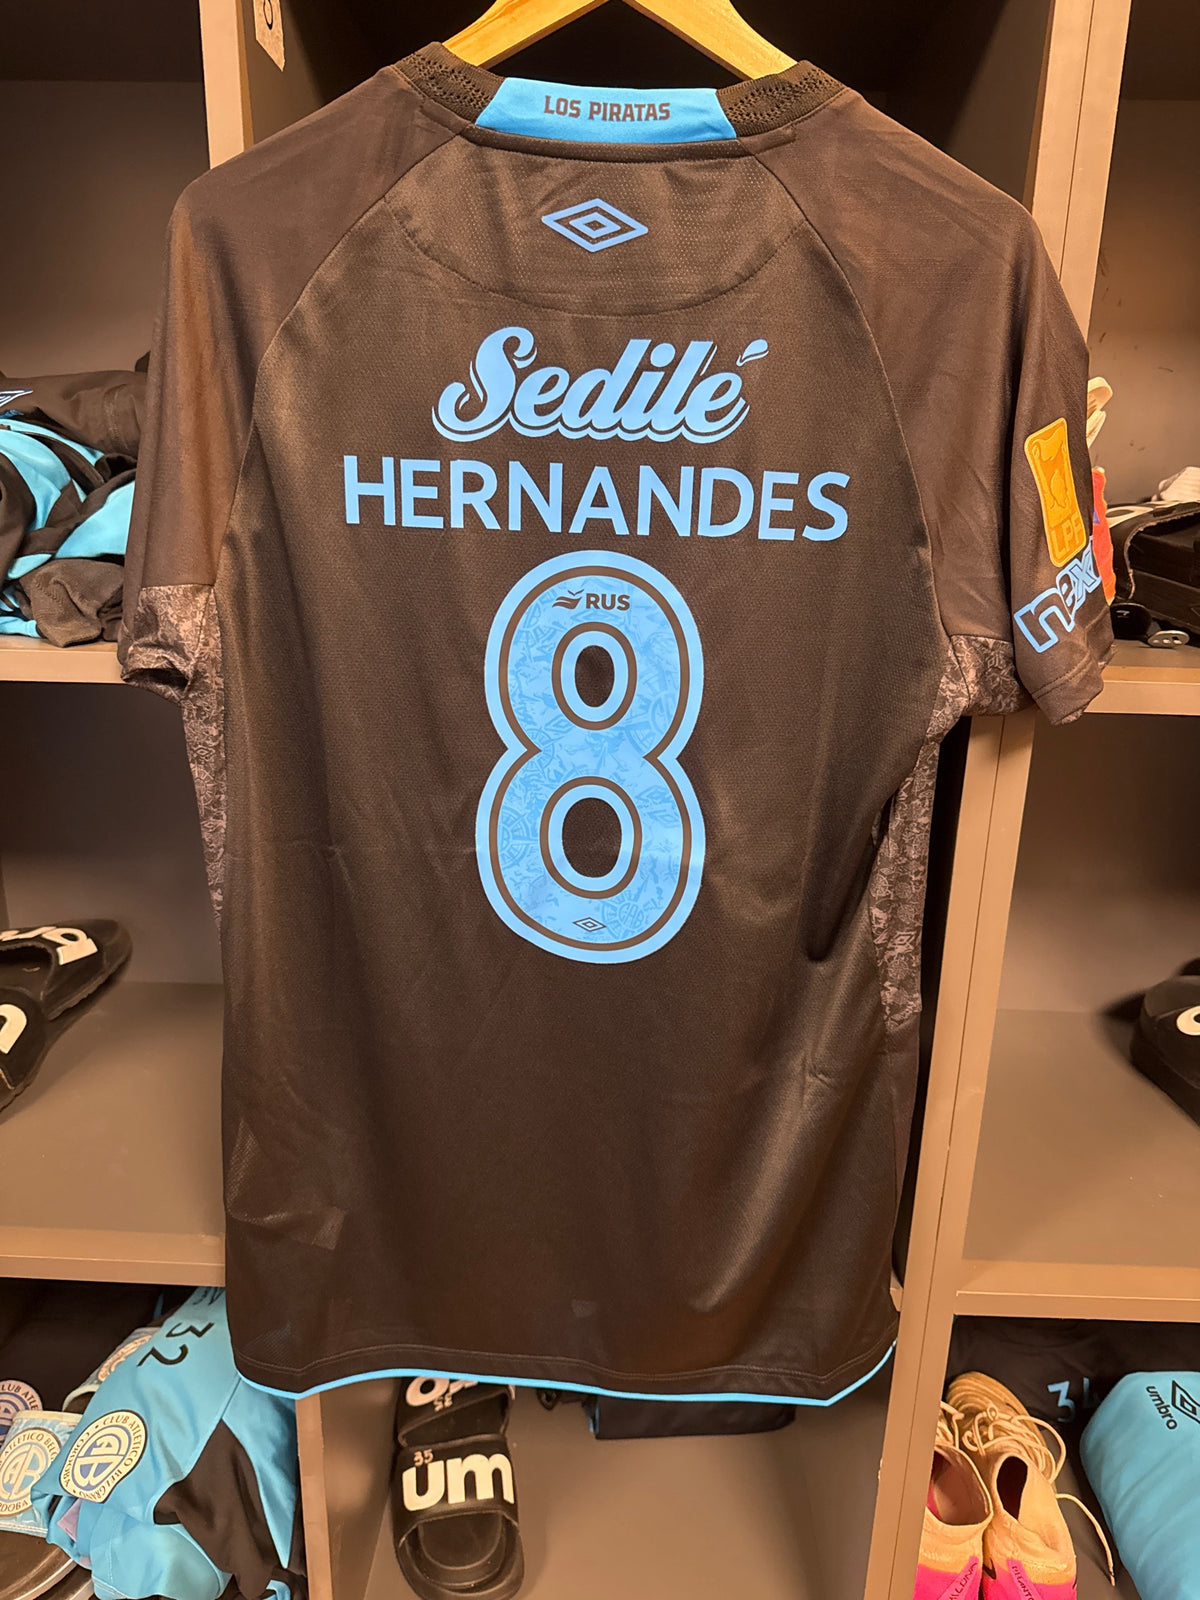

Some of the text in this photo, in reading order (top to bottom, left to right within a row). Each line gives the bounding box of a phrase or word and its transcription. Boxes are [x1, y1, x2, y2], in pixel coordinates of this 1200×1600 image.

[544, 95, 670, 121] LOS PIRATAS
[431, 327, 769, 443] Sedilé
[343, 455, 851, 541] HERNANDES
[1050, 511, 1084, 555] LPF
[586, 593, 630, 611] RUS
[1014, 536, 1101, 652] nex
[475, 550, 706, 964] 8
[1, 1384, 40, 1411] LUB ATLE
[1145, 1386, 1179, 1430] umbro
[102, 1414, 130, 1426] CLUB
[402, 1453, 515, 1512] um
[0, 1499, 28, 1513] DOBA
